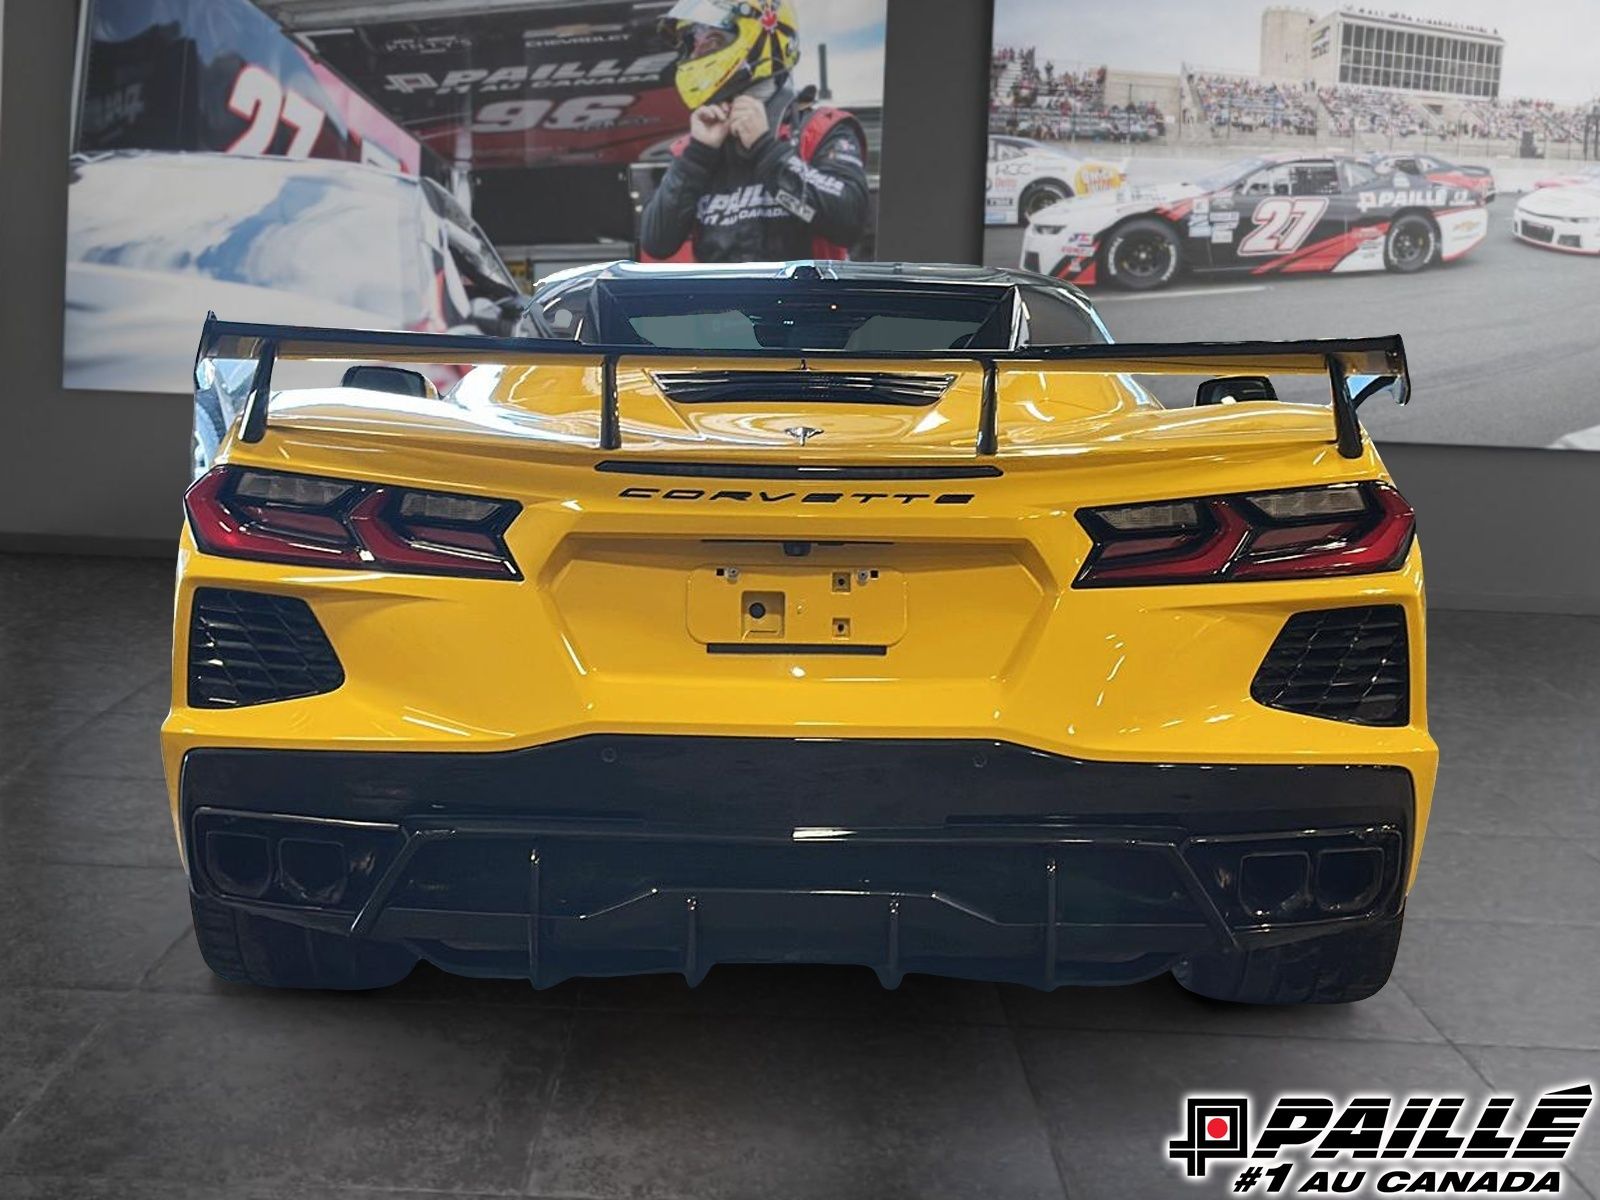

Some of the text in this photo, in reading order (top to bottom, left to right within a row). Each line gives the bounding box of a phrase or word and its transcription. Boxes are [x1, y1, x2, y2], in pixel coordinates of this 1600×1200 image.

[224, 63, 326, 159] 27
[1237, 196, 1330, 257] 27
[619, 488, 975, 504] CORVETTE
